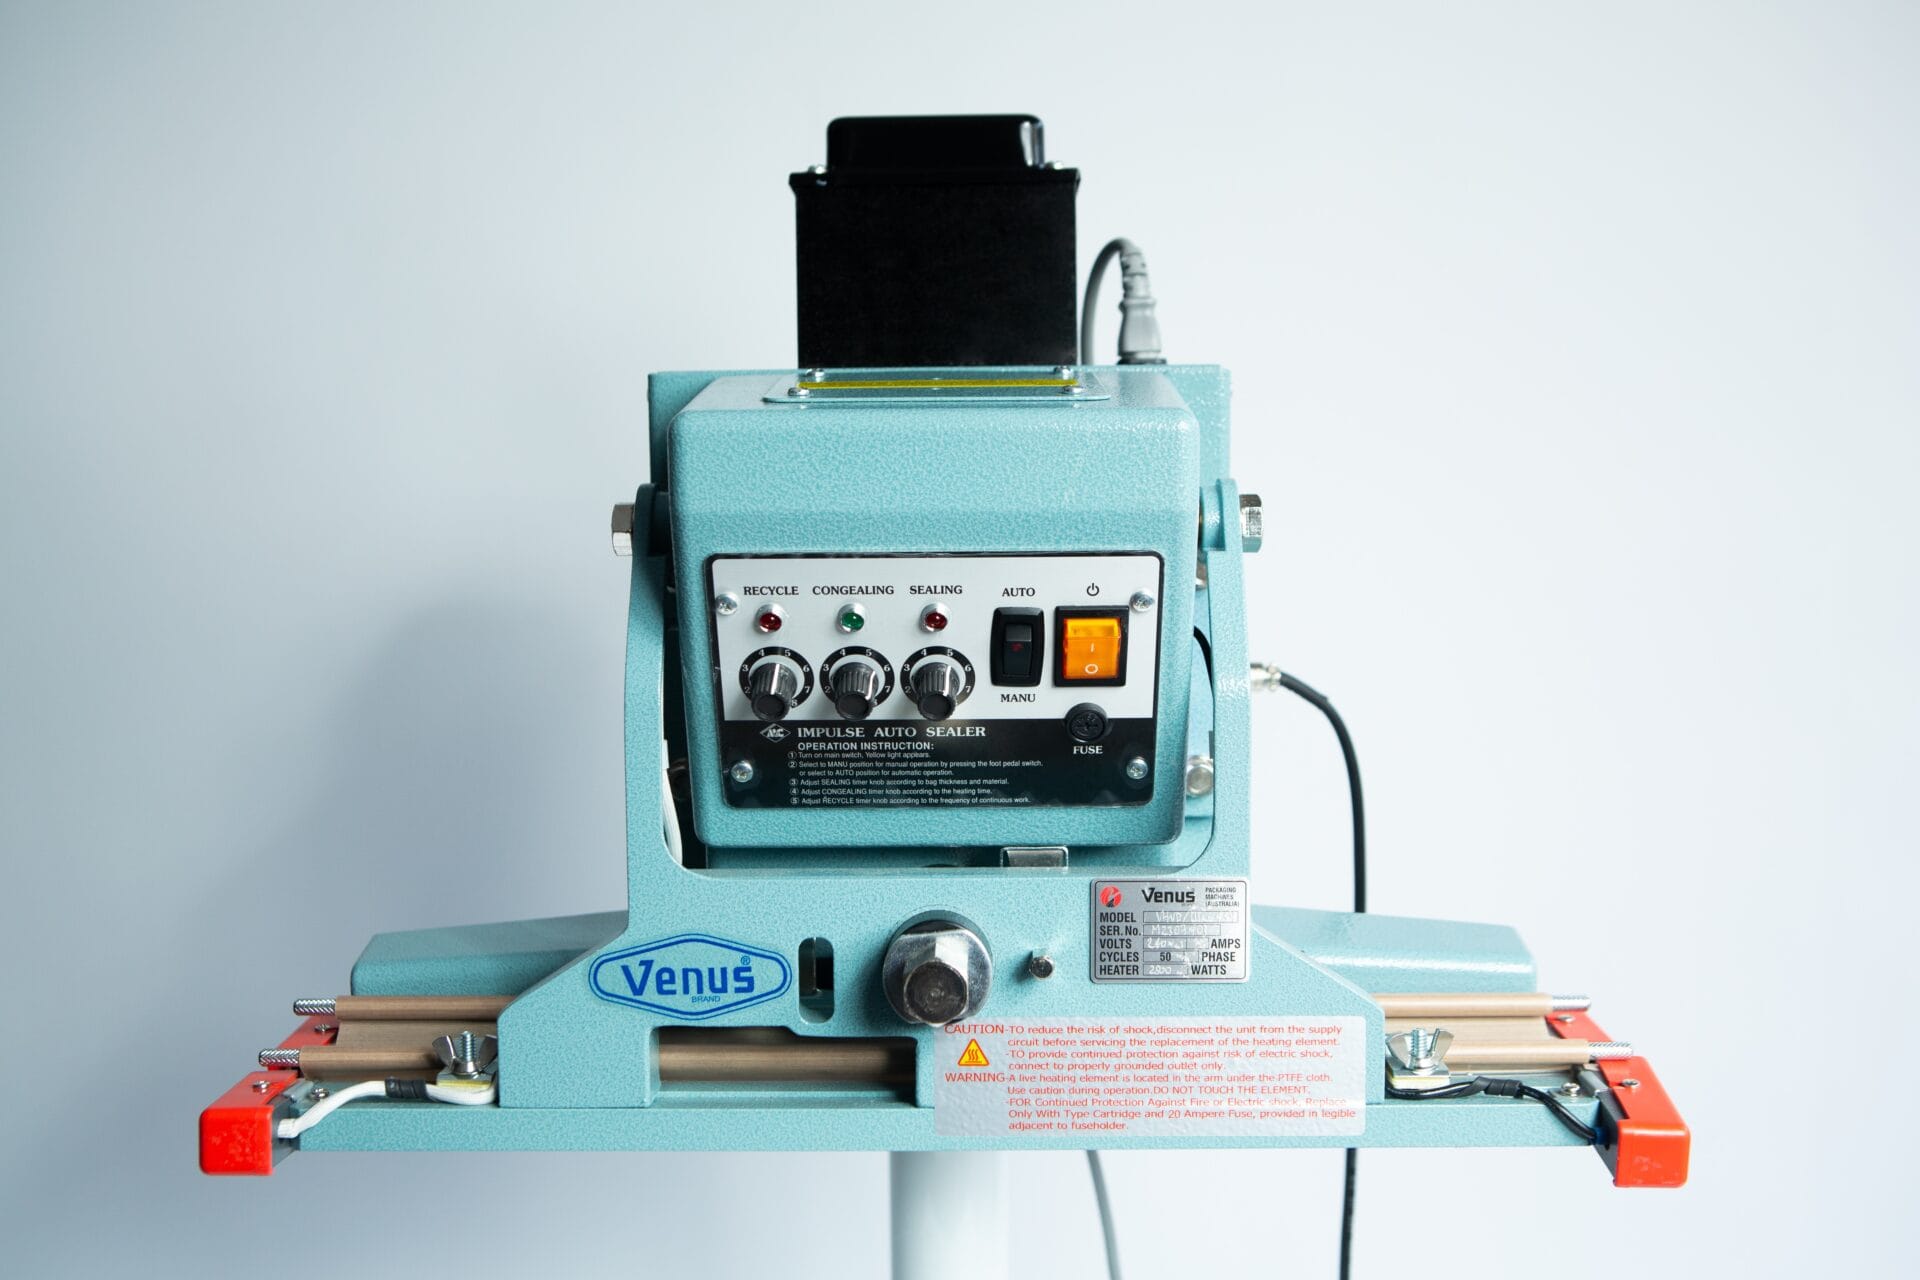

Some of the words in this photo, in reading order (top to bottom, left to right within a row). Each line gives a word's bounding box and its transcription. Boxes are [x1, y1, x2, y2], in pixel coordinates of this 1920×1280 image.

[744, 586, 799, 596] RECYCLE
[812, 585, 895, 595] CONGEALING
[909, 585, 963, 595] SEALING
[1002, 588, 1036, 597] AUTO
[1000, 693, 1036, 703] MANU
[797, 727, 865, 737] IMPULSE
[874, 727, 917, 737] AUTO
[926, 727, 986, 737] SEALER
[797, 742, 857, 751] OPERATION
[860, 742, 934, 750] INSTRUCTION:
[1073, 746, 1103, 755] FUSE
[887, 751, 901, 760] light
[849, 761, 874, 769] position
[1002, 760, 1020, 768] pedal
[821, 778, 851, 786] SEALING
[885, 779, 916, 787] according
[902, 788, 933, 796] according
[802, 797, 821, 805] Adjust
[940, 797, 971, 805] frequency
[1142, 888, 1196, 903] Venus
[1100, 912, 1136, 923] MODEL
[1100, 925, 1123, 936] SER.
[1125, 925, 1142, 936] No.
[1100, 938, 1132, 949] VOLTS
[1210, 938, 1241, 949] AMPS
[1100, 951, 1139, 962] CYCLES
[1160, 952, 1172, 961] 50
[1201, 952, 1236, 962] PHASE
[1100, 964, 1139, 975] HEATER
[1191, 964, 1227, 975] WATTS
[620, 959, 755, 996] Venus
[691, 995, 721, 1003] BRAND
[1027, 1026, 1063, 1034] reduce
[1066, 1025, 1084, 1034] the
[1087, 1025, 1105, 1034] risk
[1109, 1025, 1120, 1034] of
[1215, 1025, 1233, 1033] the
[1236, 1026, 1256, 1034] unit
[1259, 1025, 1284, 1033] from
[1287, 1025, 1305, 1033] the
[1308, 1025, 1342, 1035] supply
[1007, 1038, 1039, 1046] circuit
[1042, 1038, 1077, 1046] before
[1080, 1038, 1126, 1048] servicing
[1129, 1038, 1147, 1046] the
[1150, 1038, 1214, 1048] replacement
[1218, 1038, 1229, 1046] of
[1231, 1037, 1250, 1045] the
[1252, 1038, 1292, 1047] heating
[1295, 1038, 1339, 1046] element.
[1028, 1050, 1068, 1060] provide
[1070, 1050, 1122, 1058] continued
[1126, 1050, 1179, 1060] protection
[1182, 1050, 1219, 1059] against
[1245, 1050, 1255, 1058] of
[1259, 1050, 1296, 1058] electric
[1299, 1050, 1333, 1058] shock,
[1008, 1062, 1050, 1070] connect
[1053, 1062, 1065, 1070] to
[1067, 1062, 1111, 1072] properly
[1113, 1061, 1164, 1072] grounded
[1167, 1062, 1197, 1070] outlet
[1019, 1074, 1037, 1082] live
[1039, 1074, 1076, 1083] heating
[1079, 1074, 1119, 1082] element
[1122, 1074, 1130, 1083] is
[1133, 1074, 1169, 1082] located
[1172, 1074, 1181, 1082] in
[1184, 1074, 1201, 1082] the
[1226, 1074, 1256, 1083] under
[1258, 1074, 1275, 1082] the
[1277, 1073, 1302, 1082] PTFE
[1007, 1086, 1026, 1095] Use
[1028, 1086, 1065, 1095] caution
[1068, 1087, 1100, 1096] during
[1172, 1086, 1194, 1094] NOT
[1198, 1085, 1234, 1094] TOUCH
[1237, 1085, 1257, 1094] THE
[1260, 1086, 1310, 1094] ELEMENT.
[1035, 1098, 1088, 1107] Continued
[1091, 1098, 1144, 1106] Protection
[1148, 1098, 1186, 1108] Against
[1190, 1097, 1210, 1106] Fire
[1227, 1097, 1265, 1105] Electric
[1008, 1109, 1032, 1119] Only
[1035, 1110, 1060, 1118] With
[1064, 1109, 1090, 1120] Type
[1092, 1110, 1141, 1119] Cartridge
[1144, 1110, 1164, 1118] and
[1168, 1110, 1181, 1119] 20
[1184, 1109, 1225, 1119] Ampere
[1228, 1109, 1255, 1119] Fuse,
[1259, 1110, 1305, 1119] provided
[1321, 1109, 1356, 1119] legible
[1008, 1121, 1053, 1131] adjacent
[1057, 1122, 1068, 1130] to
[1071, 1121, 1128, 1130] fuseholder.
